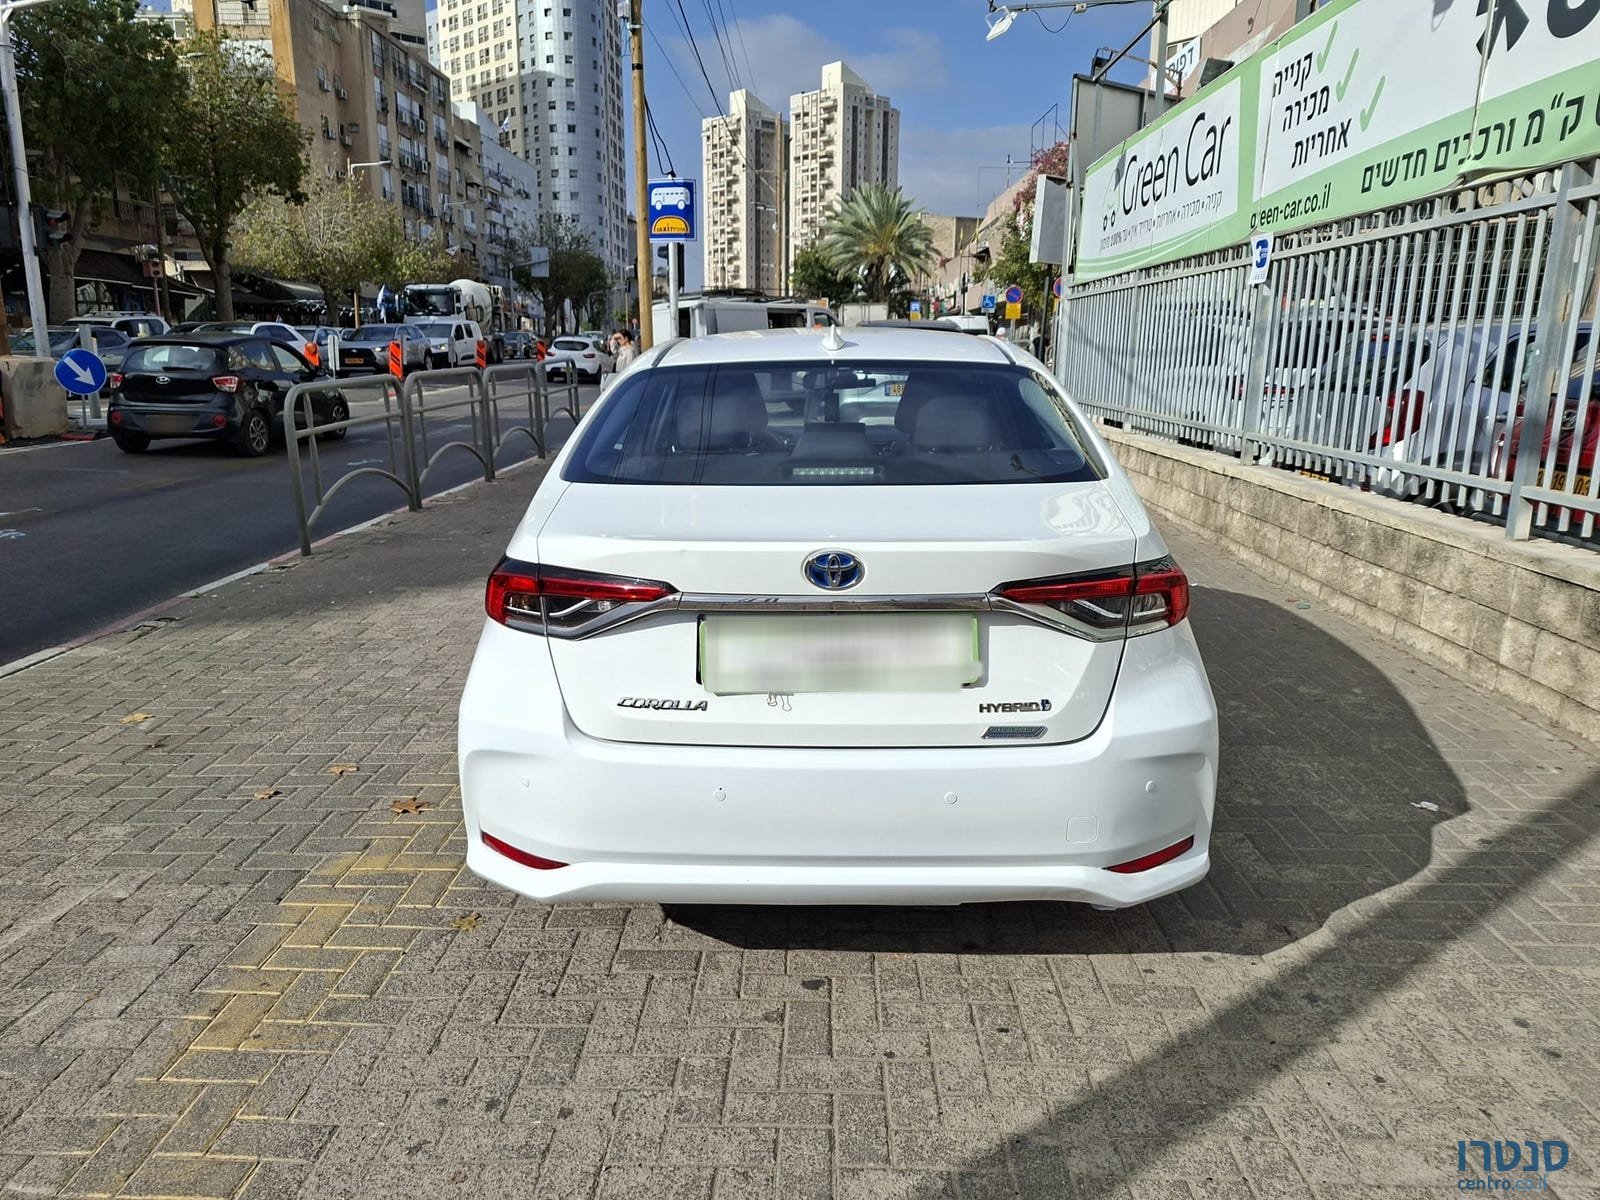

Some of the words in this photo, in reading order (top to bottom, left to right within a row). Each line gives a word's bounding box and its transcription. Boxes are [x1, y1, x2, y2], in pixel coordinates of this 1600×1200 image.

[1273, 51, 1313, 98] קנייה
[1283, 85, 1330, 132] מכירה
[1122, 146, 1179, 216] Green
[1185, 112, 1232, 187] Car
[1291, 118, 1352, 169] אחריות
[1361, 148, 1428, 194] חדשים
[1250, 182, 1331, 230] geen-car.co.il
[617, 697, 708, 711] COROLLA
[979, 702, 1041, 713] HYBRID
